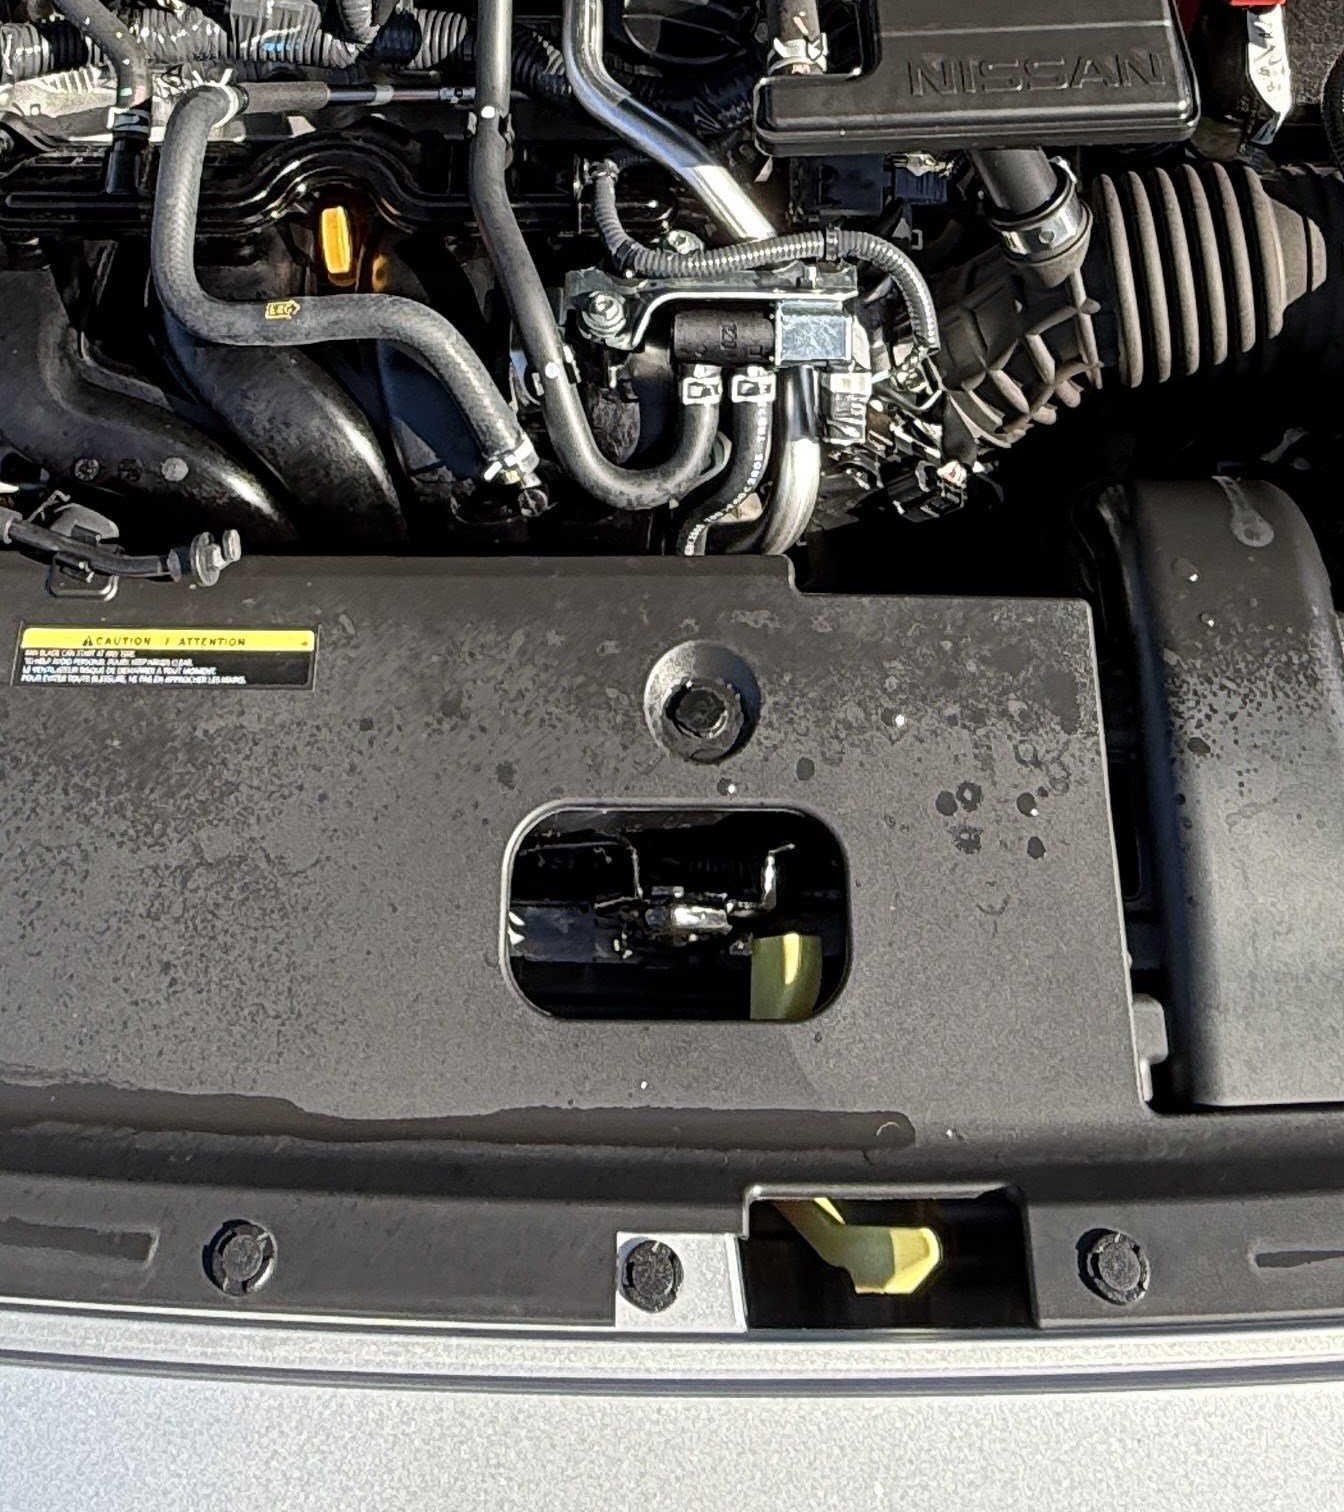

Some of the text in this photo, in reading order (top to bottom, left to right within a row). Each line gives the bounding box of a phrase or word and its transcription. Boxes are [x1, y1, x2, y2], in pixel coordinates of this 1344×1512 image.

[907, 48, 1167, 97] NISSAN
[96, 637, 152, 647] CAUTION
[178, 637, 246, 647] ATTENTION
